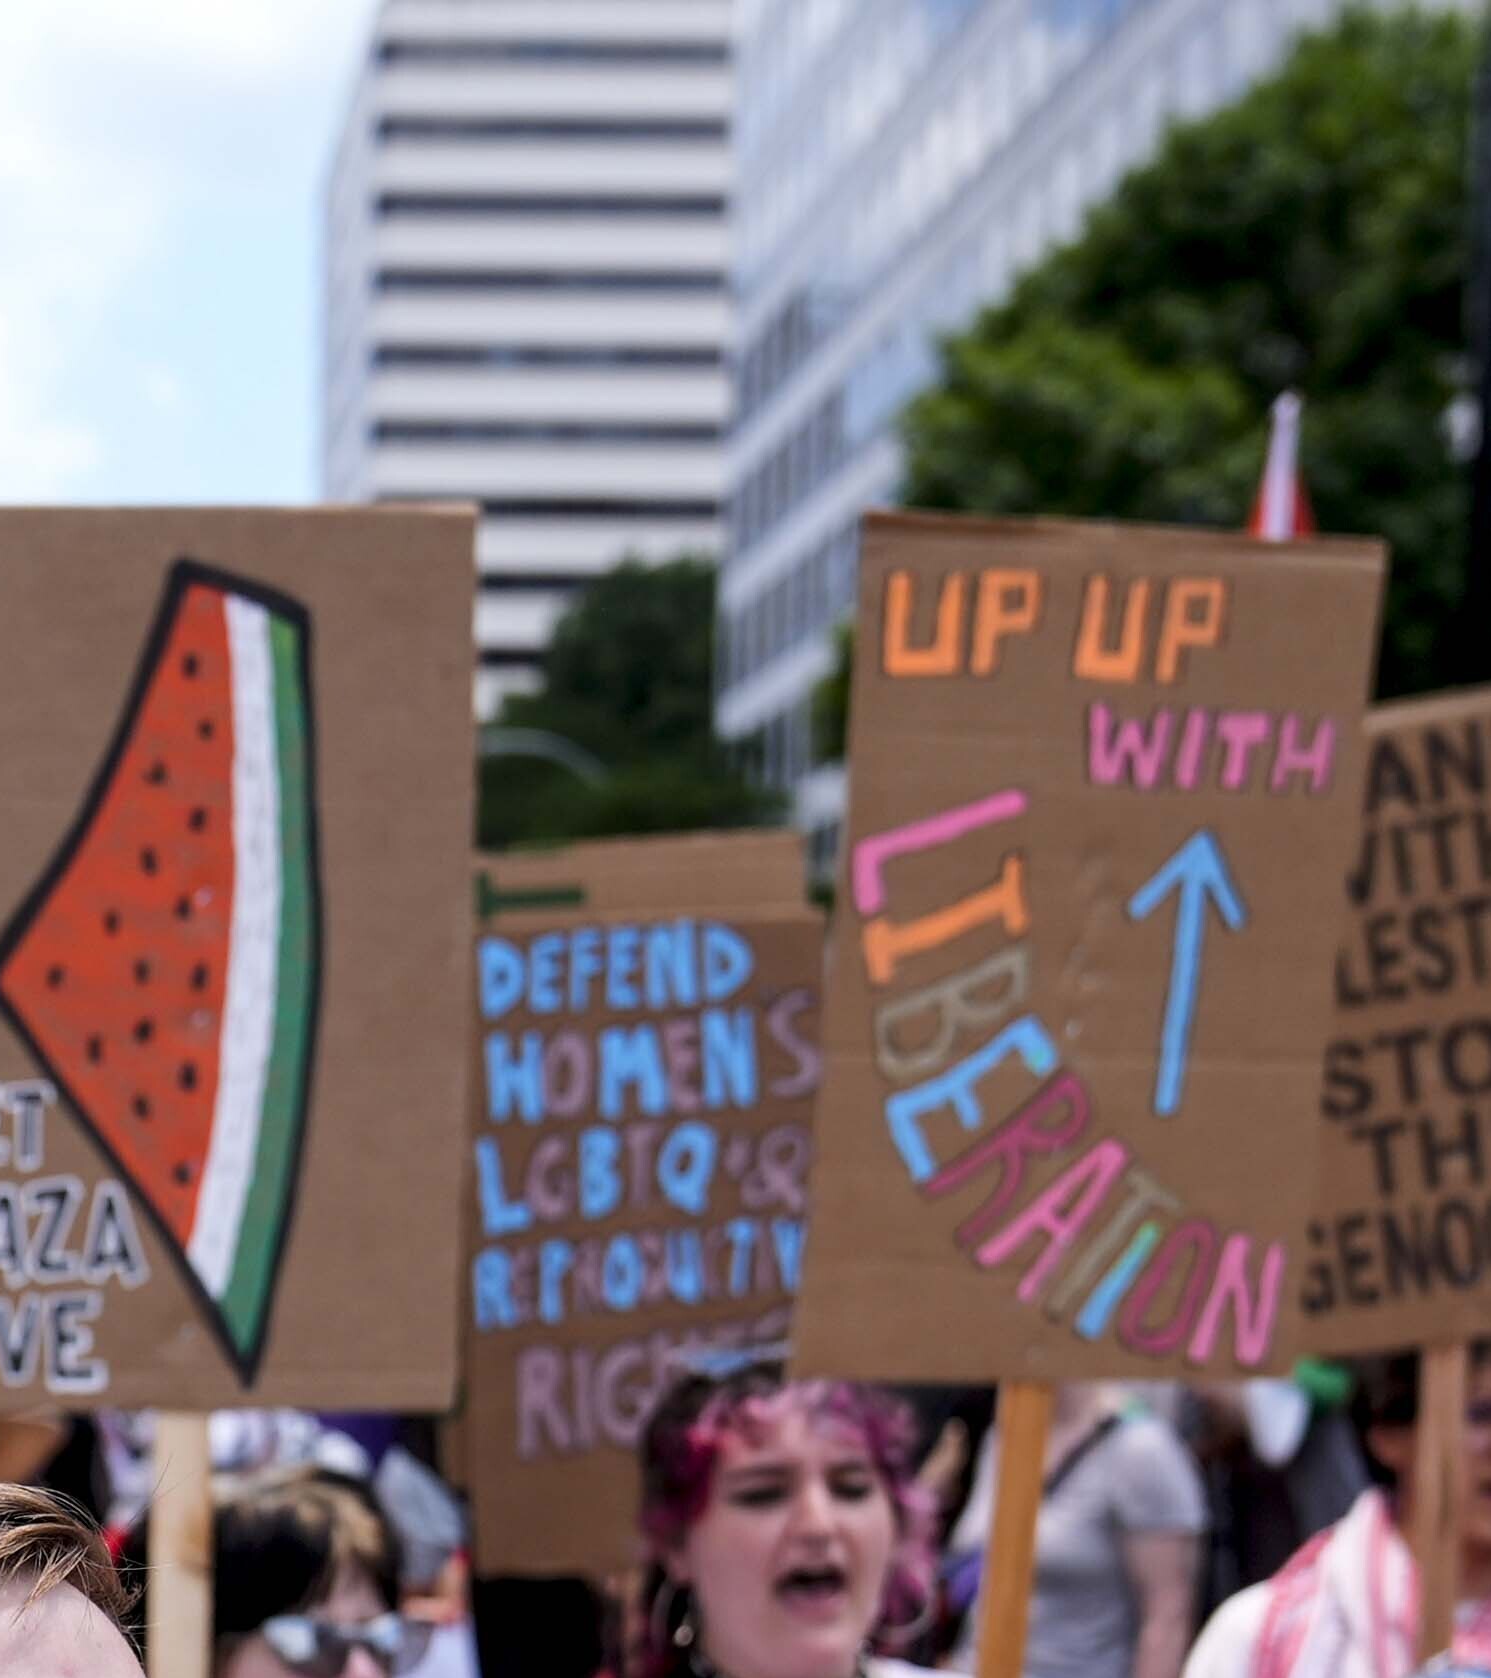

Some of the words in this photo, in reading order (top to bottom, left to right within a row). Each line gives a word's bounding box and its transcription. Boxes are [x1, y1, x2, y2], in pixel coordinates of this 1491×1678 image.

[882, 567, 1041, 676] UP
[1073, 573, 1226, 685] UP
[1086, 702, 1337, 792] WITH
[477, 918, 755, 1020] DEFEND
[852, 790, 1285, 1366] LIBERATION
